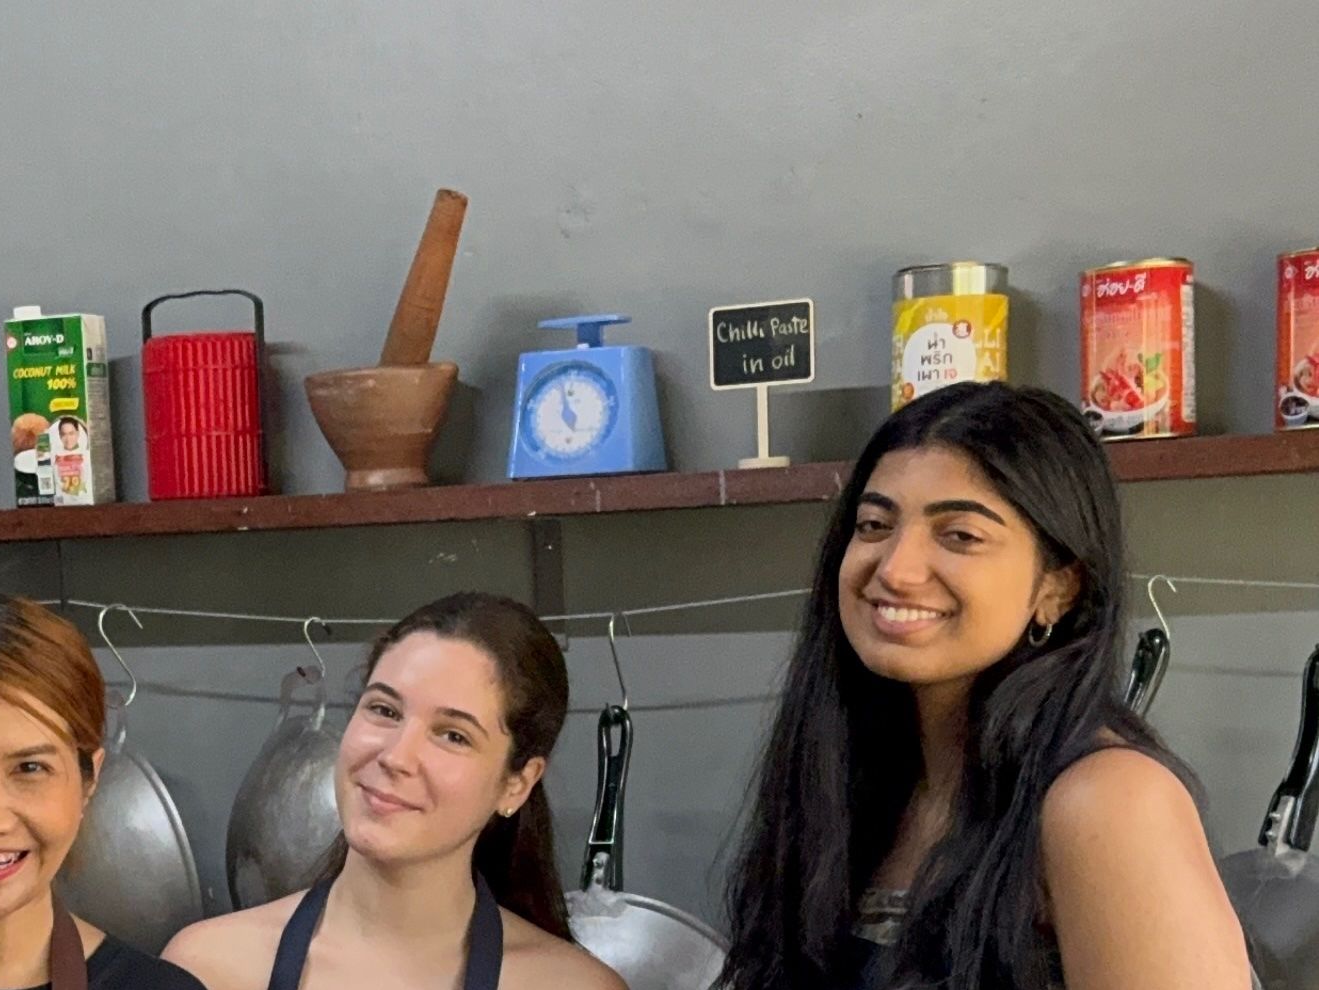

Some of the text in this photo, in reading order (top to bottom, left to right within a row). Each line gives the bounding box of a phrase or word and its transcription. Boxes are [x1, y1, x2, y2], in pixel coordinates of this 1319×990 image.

[770, 316, 809, 338] Paste
[24, 334, 65, 346] AROY-D
[742, 344, 796, 375] in oil
[13, 364, 76, 380] COCONUT MILK
[46, 378, 77, 391] 100%
